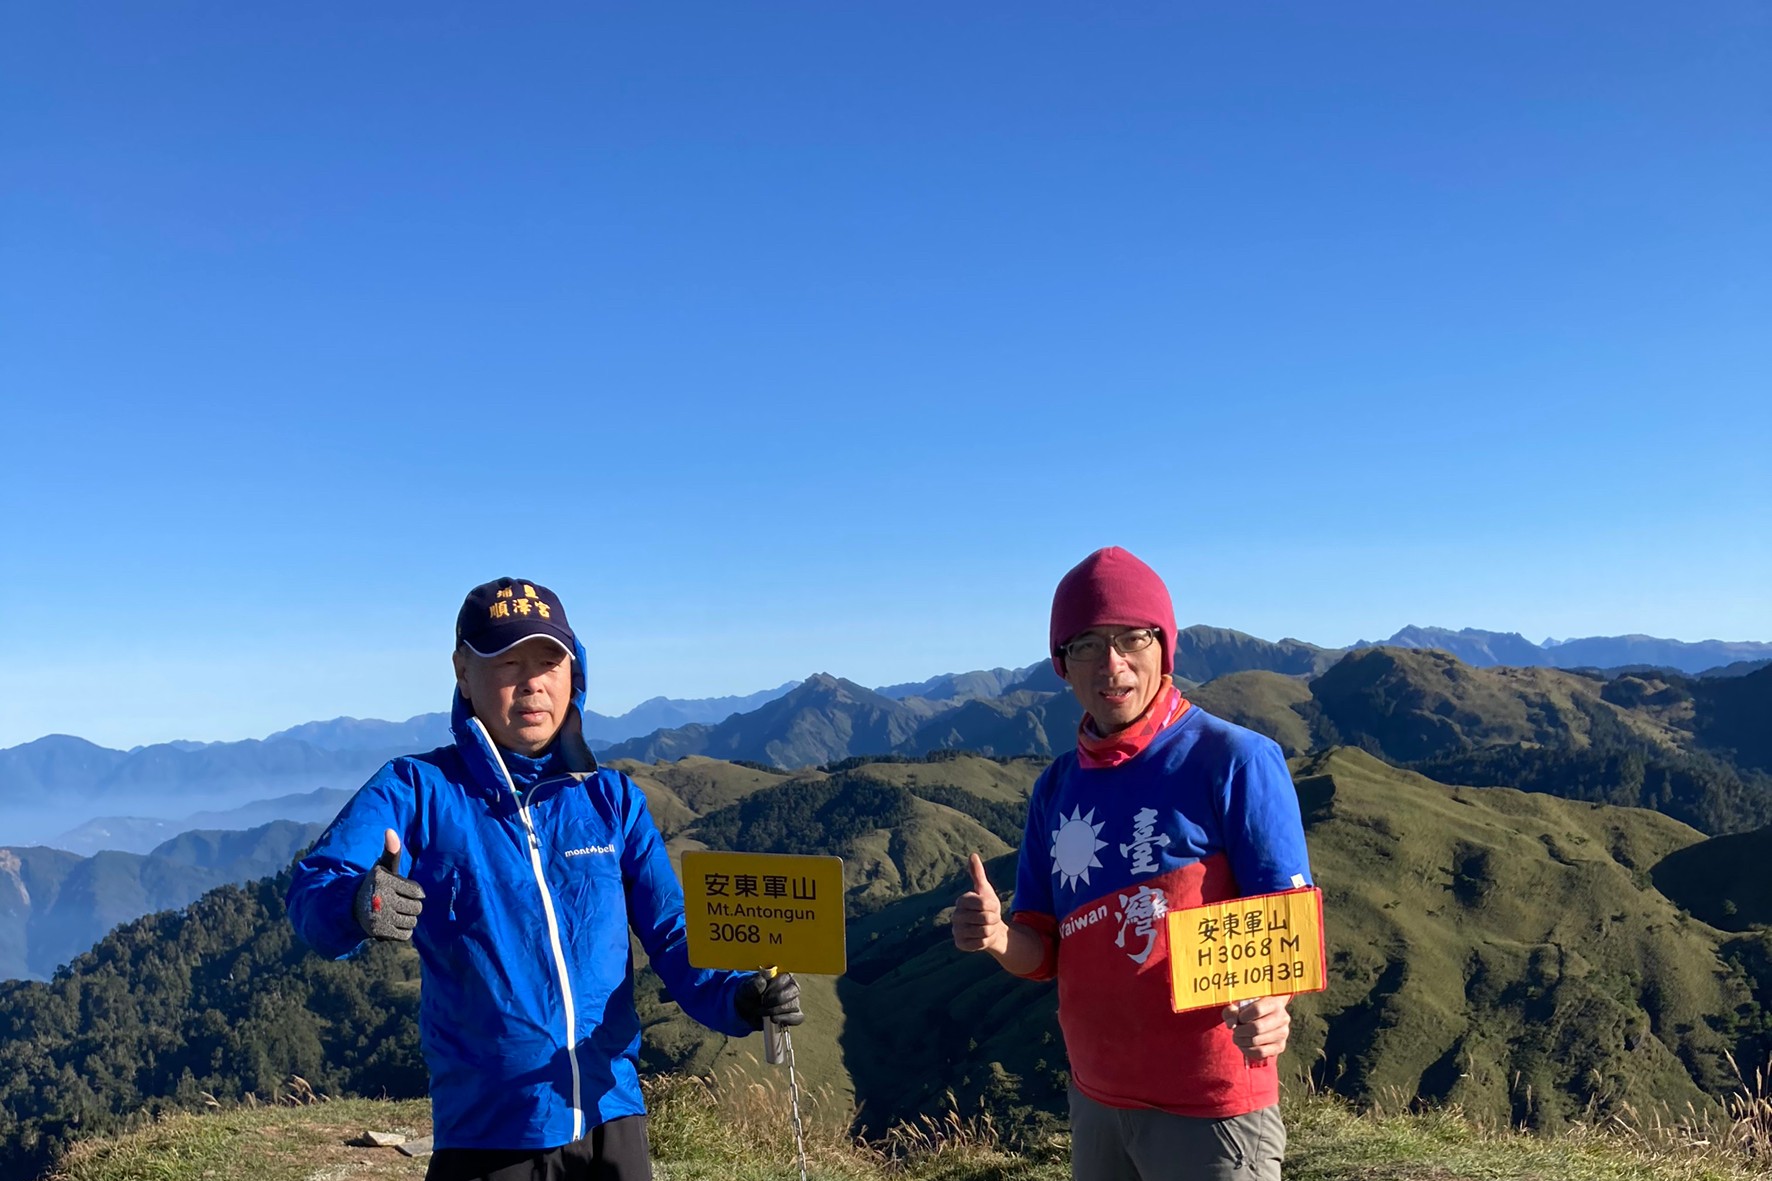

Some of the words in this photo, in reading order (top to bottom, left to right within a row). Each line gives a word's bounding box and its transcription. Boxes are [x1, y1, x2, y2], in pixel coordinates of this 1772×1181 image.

[705, 873, 816, 900] 安東軍山
[707, 902, 815, 922] Mt.Antongun
[709, 923, 760, 943] 3068
[769, 933, 783, 944] M
[1198, 910, 1287, 944] 安東軍山
